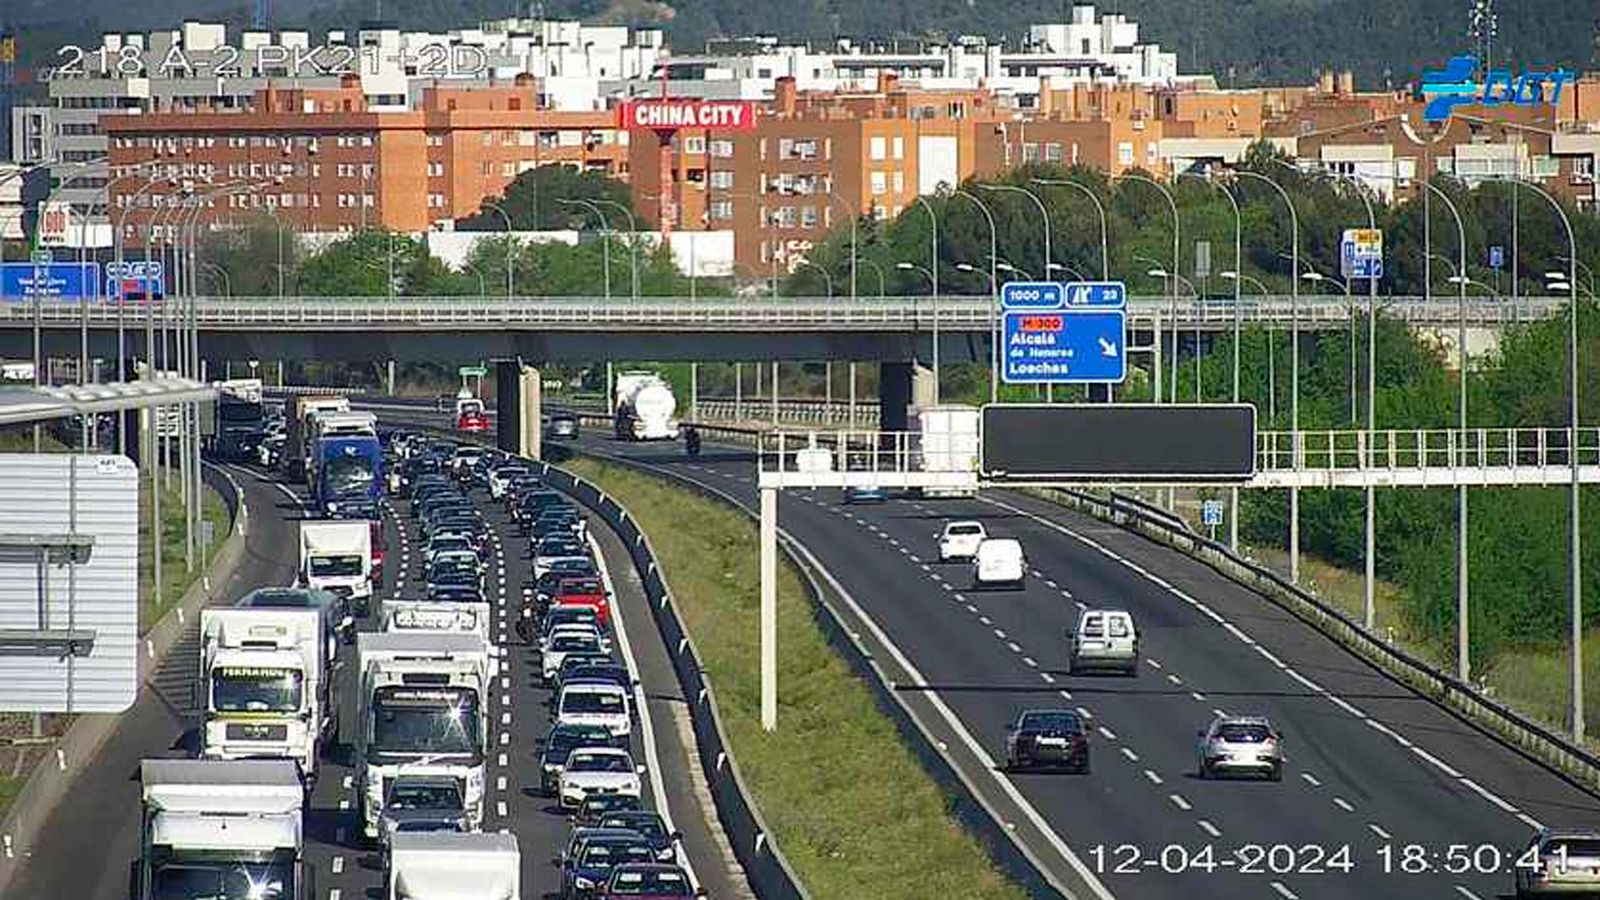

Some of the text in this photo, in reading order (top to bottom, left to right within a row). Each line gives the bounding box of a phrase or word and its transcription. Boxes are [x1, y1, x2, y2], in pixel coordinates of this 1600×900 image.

[635, 104, 743, 126] CHINA CITY
[1009, 290, 1040, 301] 1000
